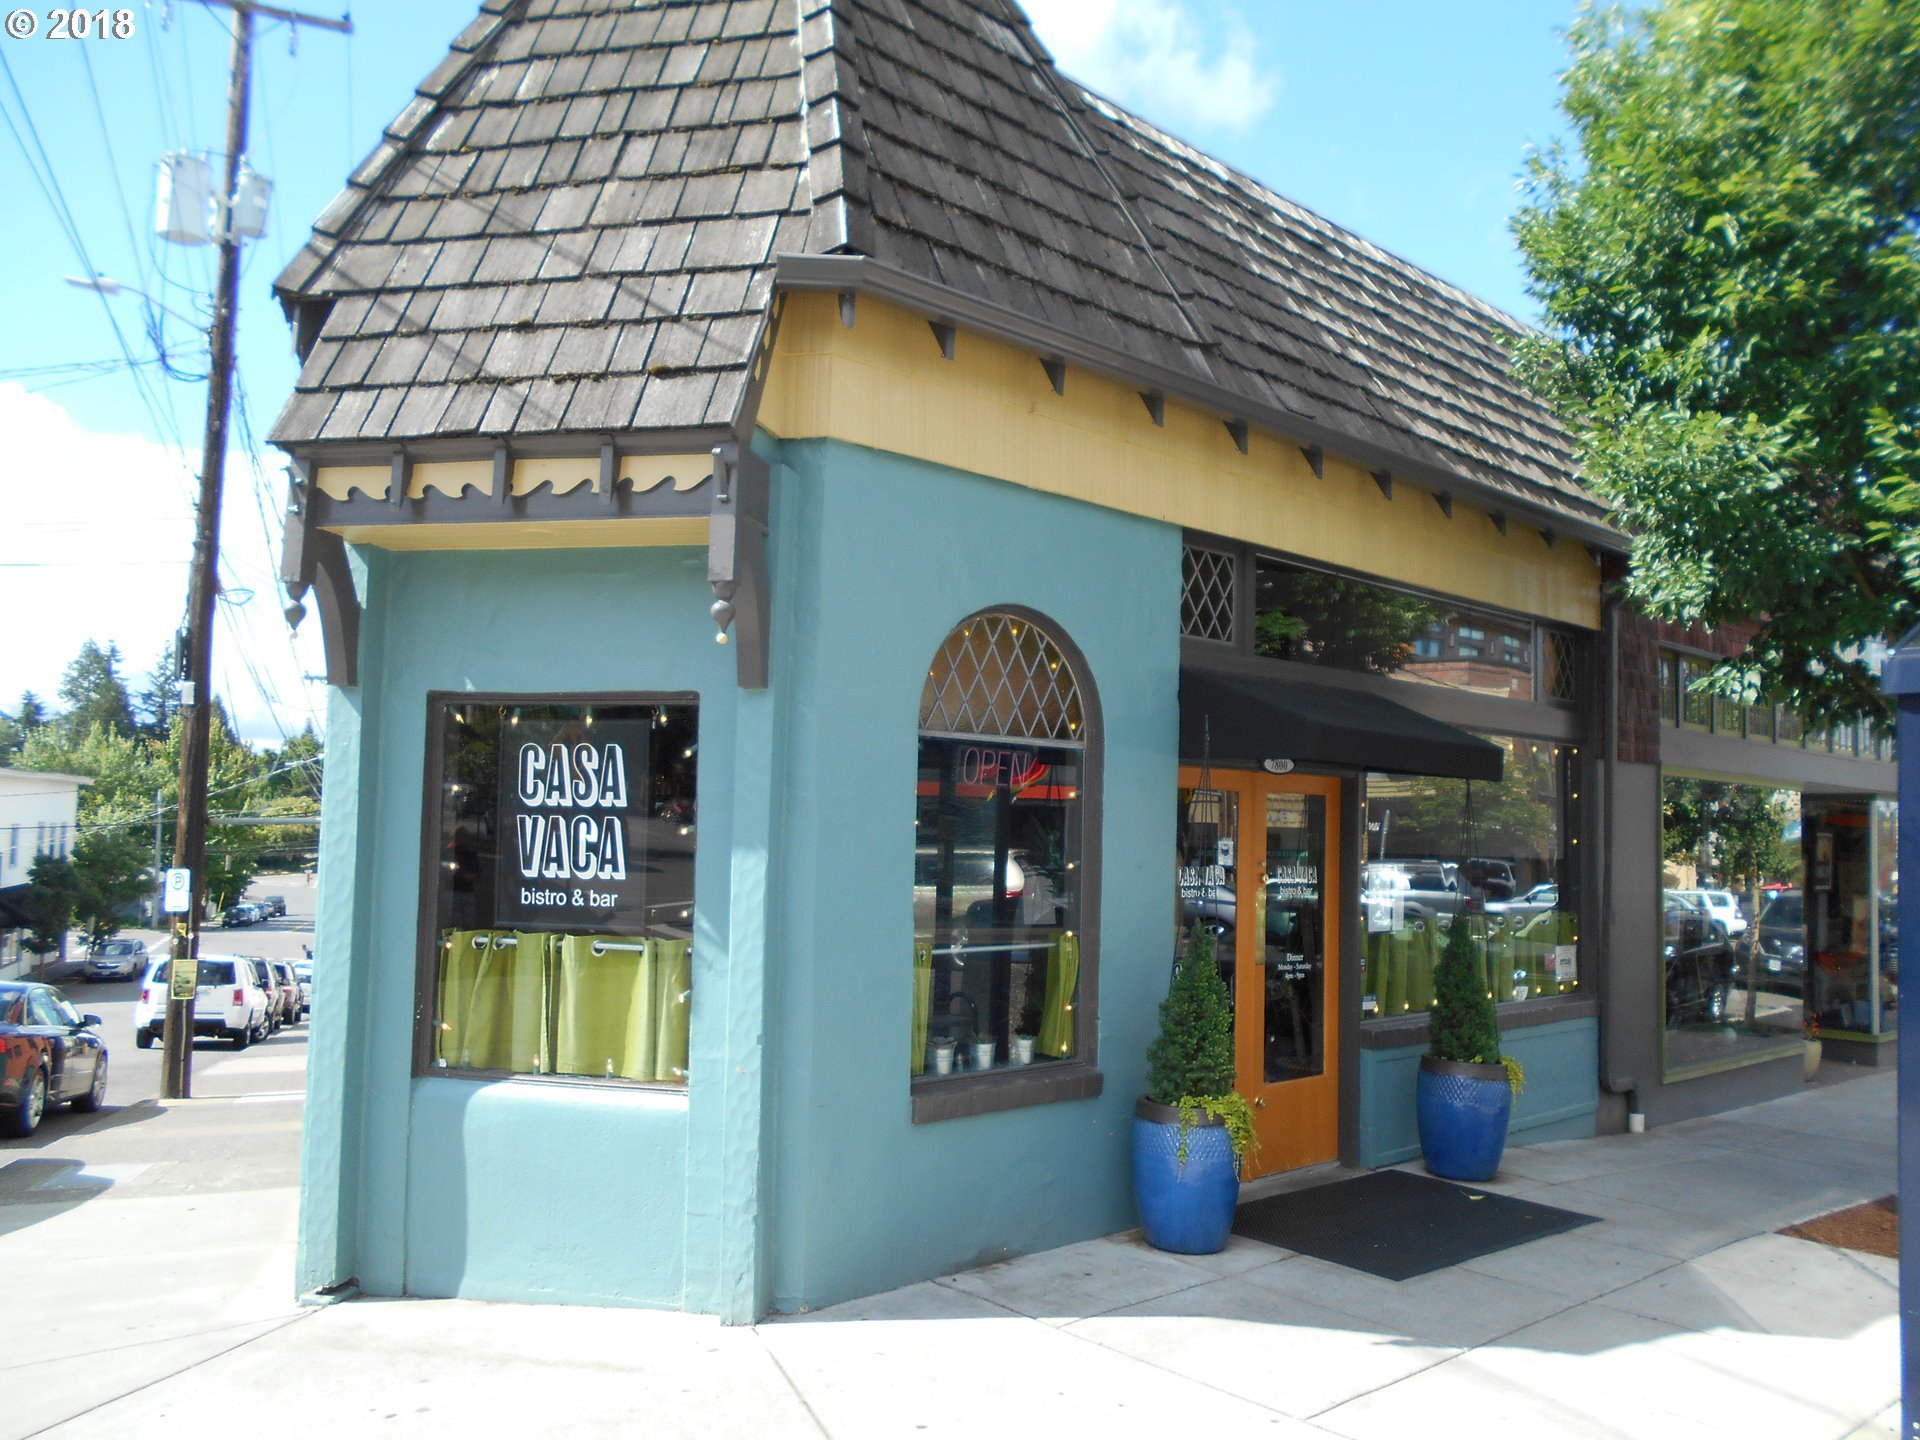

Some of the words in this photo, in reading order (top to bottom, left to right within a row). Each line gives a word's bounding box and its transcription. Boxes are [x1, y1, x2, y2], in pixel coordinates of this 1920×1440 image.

[518, 743, 628, 807] CASA
[963, 747, 1028, 788] OPEN
[516, 815, 626, 880] VACA
[1178, 866, 1201, 886] CASA
[1277, 865, 1296, 884] CASA
[521, 887, 567, 906] bistro
[572, 888, 585, 907] &
[589, 889, 618, 908] bar
[1181, 888, 1200, 898] bistro
[1279, 886, 1297, 896] bistro
[1302, 887, 1313, 895] bar
[1286, 953, 1304, 962] Dinner
